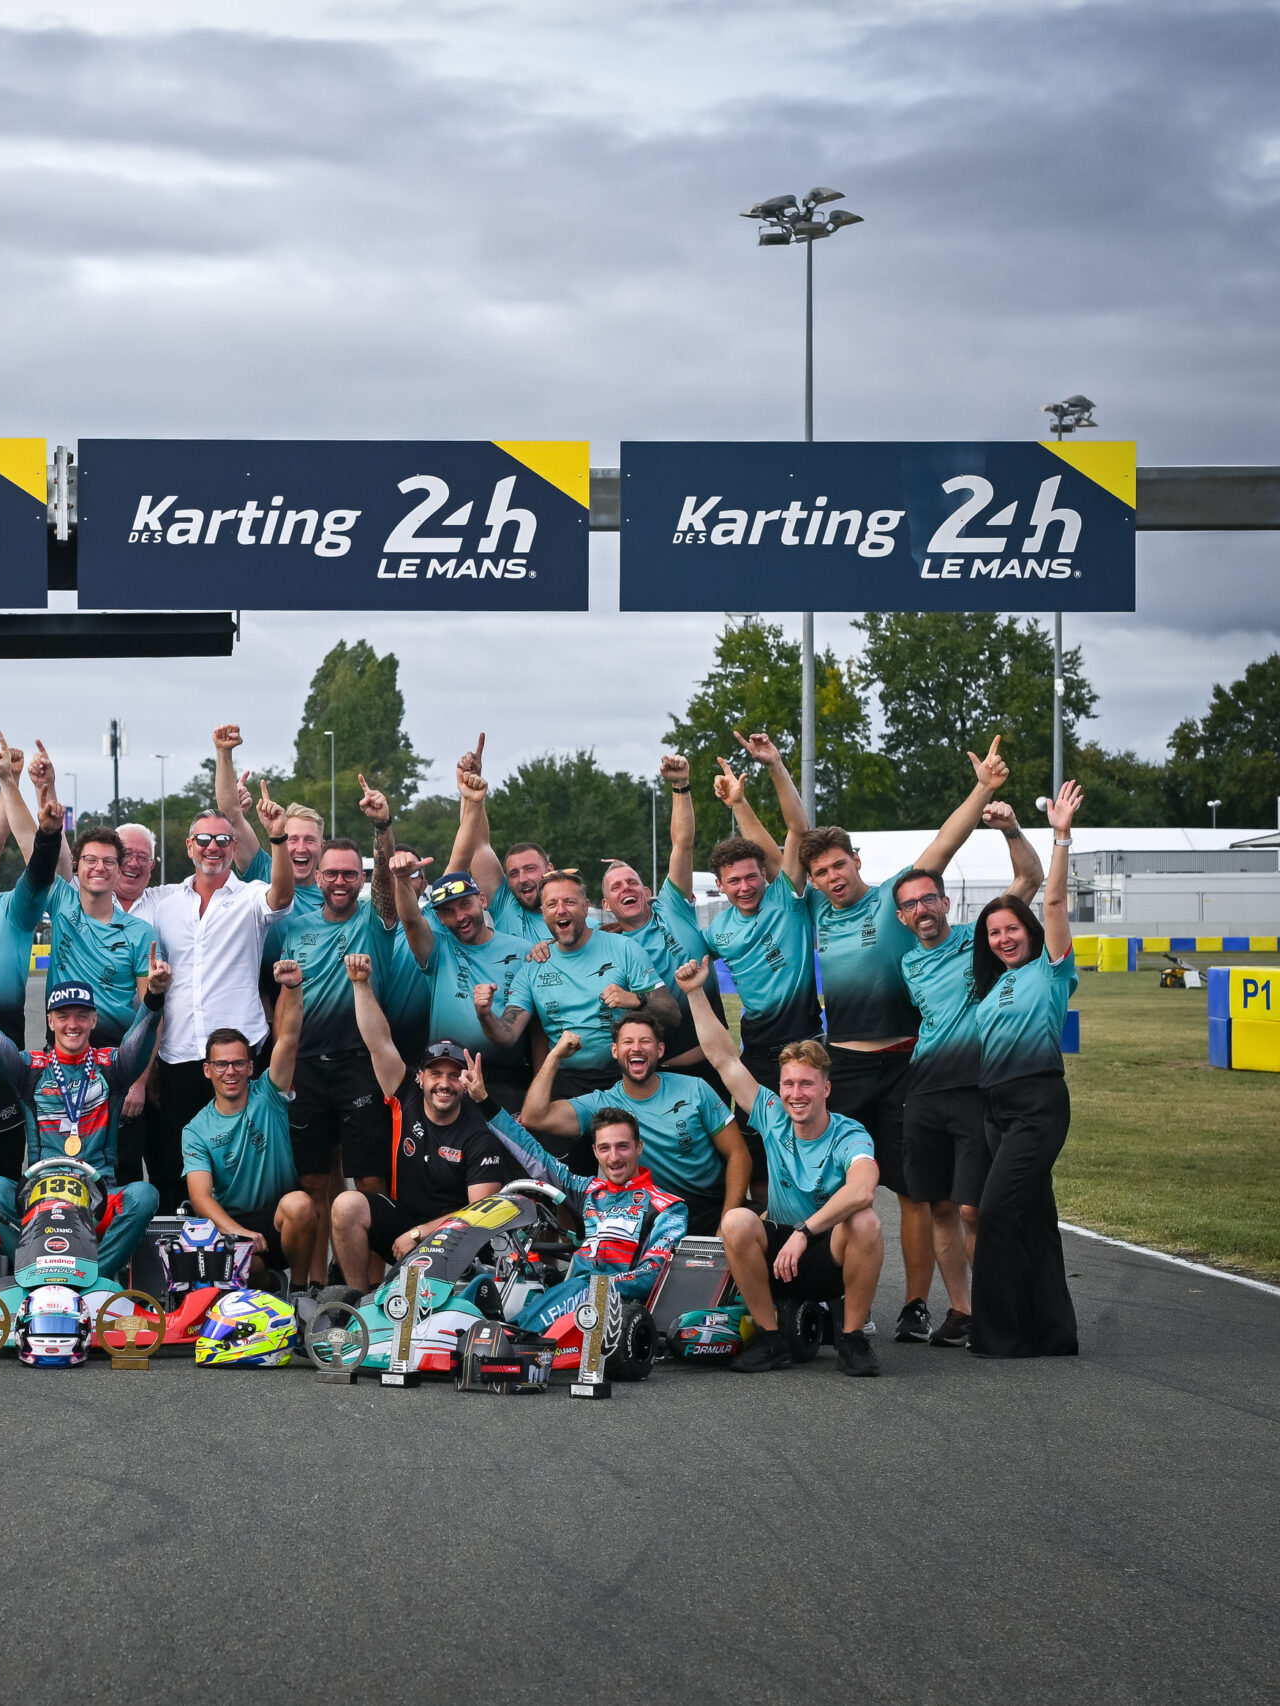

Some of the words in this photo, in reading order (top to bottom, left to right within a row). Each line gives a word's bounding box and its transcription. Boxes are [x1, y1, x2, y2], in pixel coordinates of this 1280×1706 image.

[382, 475, 537, 553] 24h
[926, 475, 1082, 553] 24h
[132, 495, 362, 557] Karting
[676, 496, 906, 557] Karting
[128, 531, 162, 544] DES
[672, 532, 707, 544] DES
[377, 558, 421, 578] LE
[426, 558, 528, 578] MANS
[920, 558, 965, 579] LE
[970, 558, 1072, 579] MANS
[862, 929, 877, 937] OMP
[765, 949, 781, 961] OMP
[1242, 978, 1271, 1010] P1
[36, 1178, 82, 1197] 133
[44, 1226, 73, 1234] ALFANO
[44, 1256, 75, 1265] Lindner
[26, 1268, 86, 1280] FORMULAK
